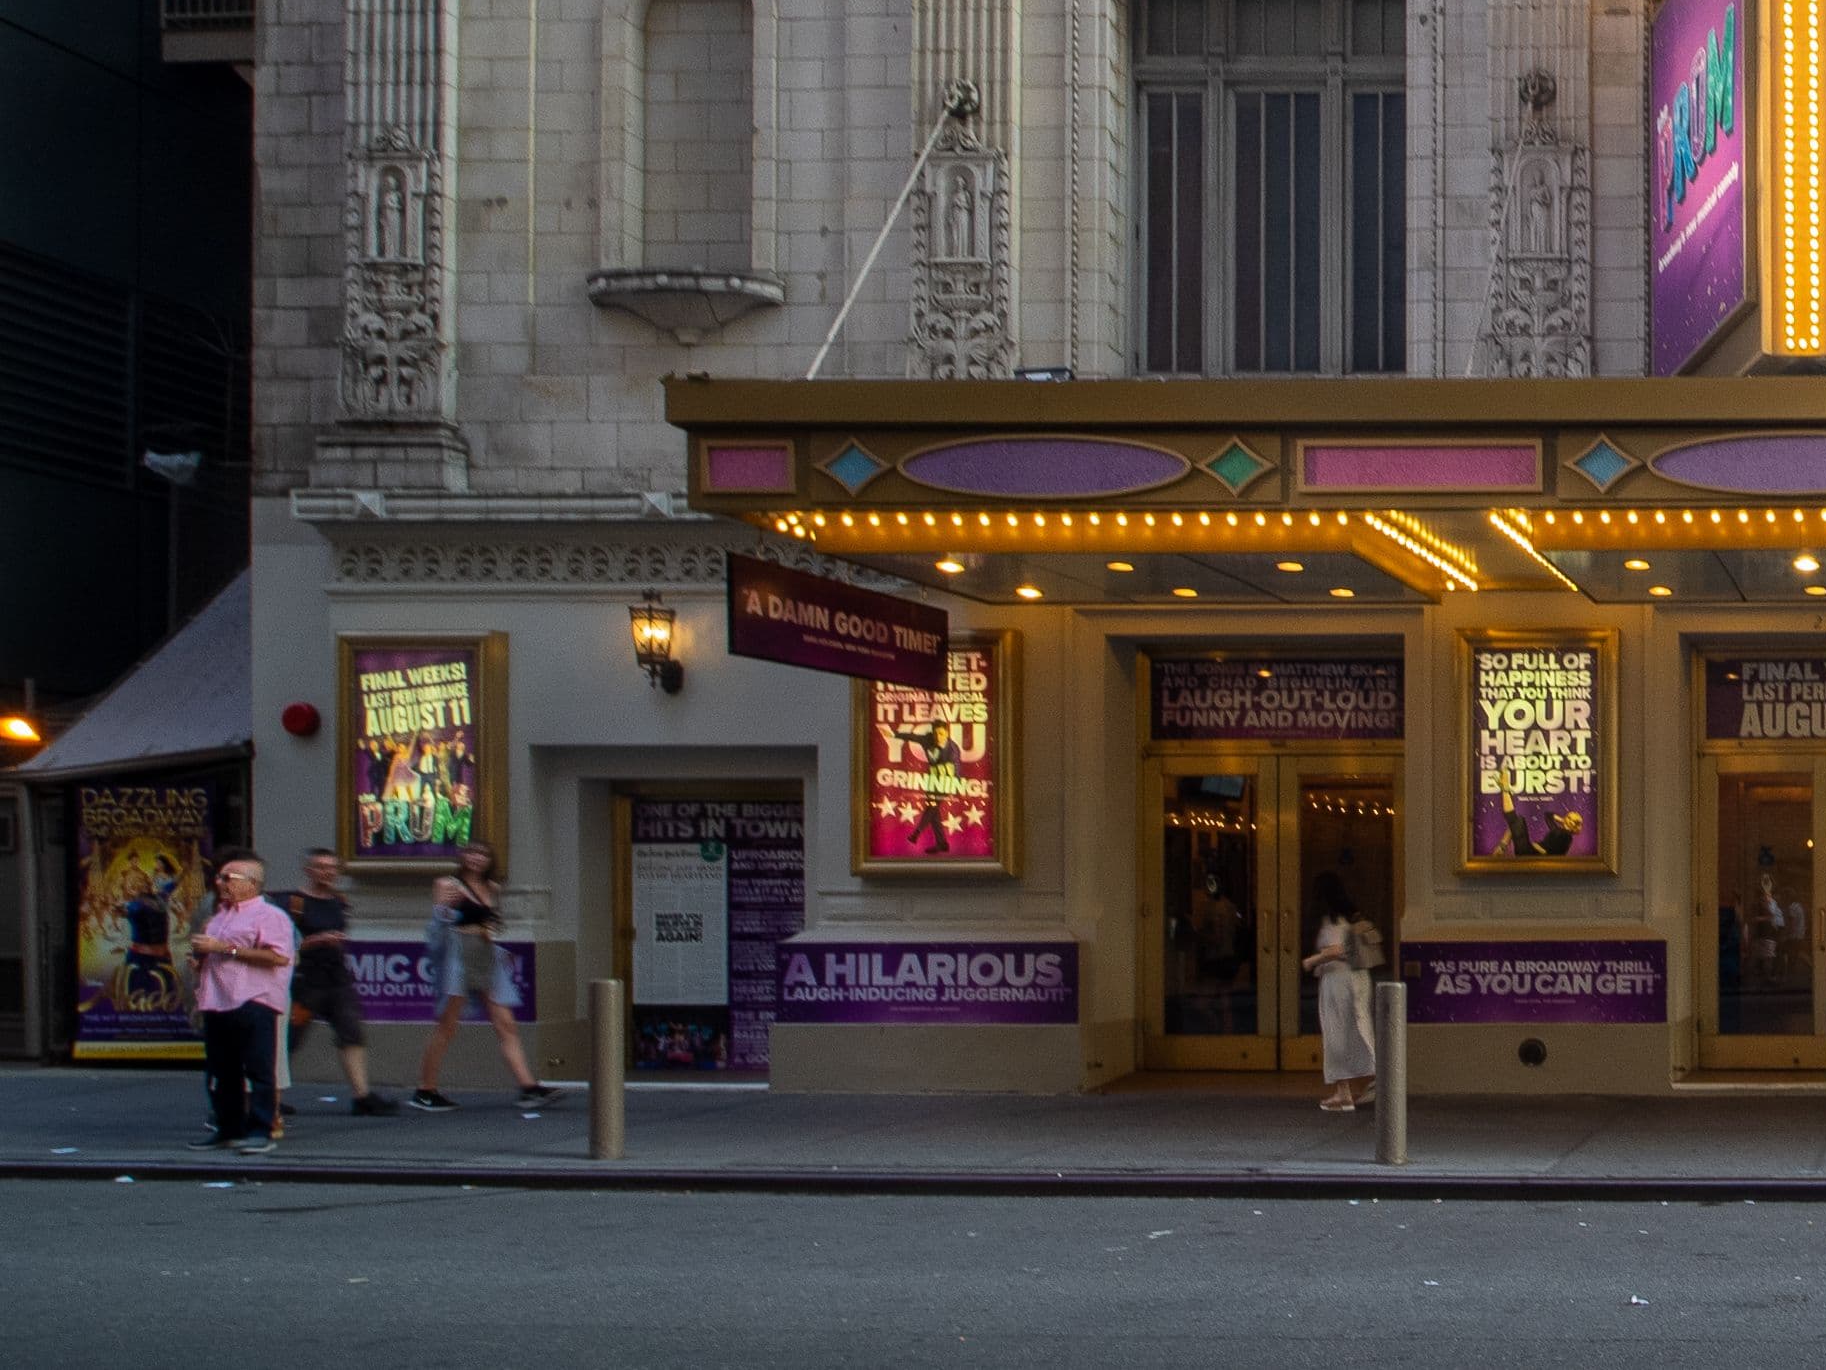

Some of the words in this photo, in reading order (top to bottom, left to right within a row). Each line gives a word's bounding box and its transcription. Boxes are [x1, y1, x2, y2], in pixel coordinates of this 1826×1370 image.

[1658, 2, 1735, 232] PROM
[768, 593, 830, 632] DAMN
[834, 610, 889, 643] GOOD
[1511, 652, 1560, 671] FULL
[1563, 653, 1591, 671] OF
[1742, 661, 1820, 679] FINAL
[360, 670, 408, 691] FINAL
[406, 661, 468, 686] WEEKS!
[1162, 677, 1199, 689] AND
[1208, 677, 1257, 689] CHAD
[1480, 670, 1592, 687] HAPPINESS
[363, 692, 391, 708] LAST
[392, 682, 470, 707] PERFORMANCE
[876, 691, 931, 703] ORIGINAL
[1162, 689, 1397, 710] LAUGH-OUT-LOUD
[1480, 687, 1516, 701] THAT
[1519, 687, 1548, 701] YOU
[1550, 687, 1592, 700] THINK
[1742, 681, 1787, 701] LAST
[366, 700, 446, 737] AUGUST
[451, 698, 471, 727] 11
[877, 703, 899, 722] IT
[902, 703, 989, 722] LEAVES
[1161, 710, 1240, 727] FUNNY
[1244, 710, 1293, 727] AND
[1479, 699, 1592, 731] YOUR
[1480, 730, 1592, 755] HEART
[1480, 755, 1497, 770] IS
[1501, 754, 1563, 770] ABOUT
[1567, 755, 1592, 770] TO
[81, 787, 208, 809] DAZZLING
[83, 809, 206, 827] BROADWAY
[636, 803, 673, 817] ONE
[677, 803, 700, 817] OF
[704, 803, 737, 817] THE
[360, 796, 473, 848] PROM
[637, 819, 694, 839] HITS
[700, 818, 726, 839] IN
[345, 953, 412, 983] MIC
[825, 953, 1064, 987] HILARIOUS
[1459, 960, 1499, 973] PURE
[1501, 960, 1513, 973] A
[1515, 960, 1600, 973] BROADWAY
[1605, 960, 1655, 973] THRILL
[383, 983, 419, 997] OUT
[784, 987, 937, 1002] LAUGH-INDUCING
[1434, 974, 1472, 995] AS
[1474, 974, 1532, 995] YOU
[1535, 974, 1593, 995] CAN
